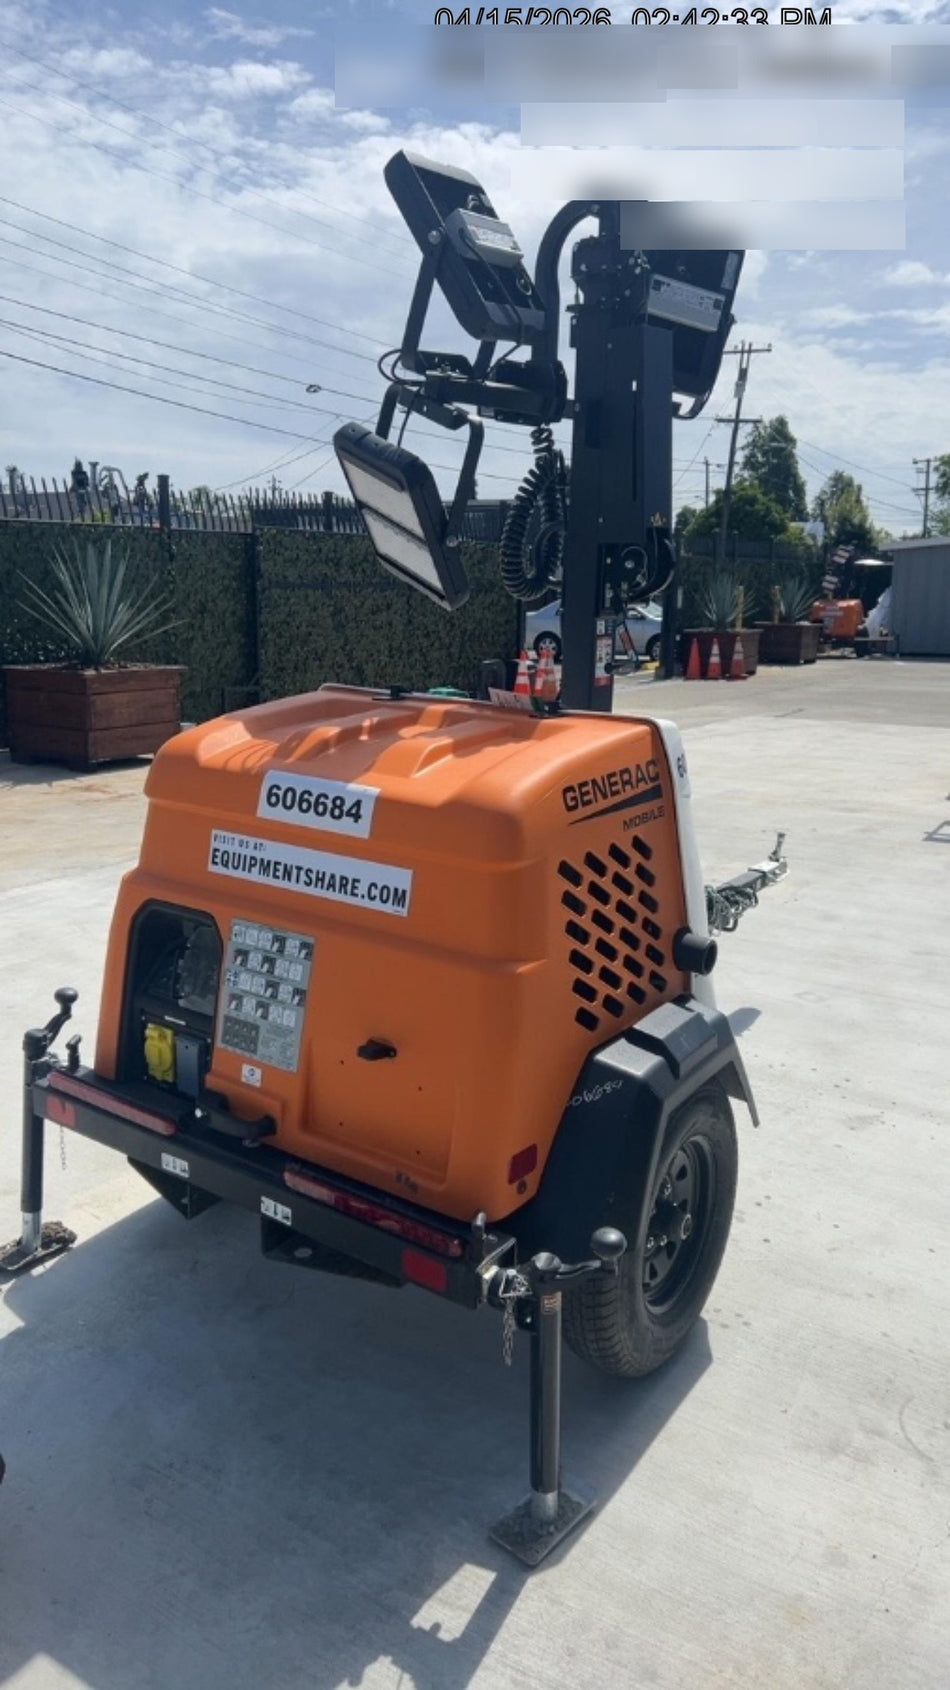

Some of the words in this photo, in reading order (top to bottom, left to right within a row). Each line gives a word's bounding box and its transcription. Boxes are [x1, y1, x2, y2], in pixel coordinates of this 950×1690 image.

[265, 783, 363, 824] 606684
[562, 758, 661, 813] GENERAC
[622, 805, 665, 832] MOBILE
[213, 833, 235, 846] VISIT
[238, 839, 250, 849] US
[210, 847, 408, 909] EQUIPMENTSHARE.COM
